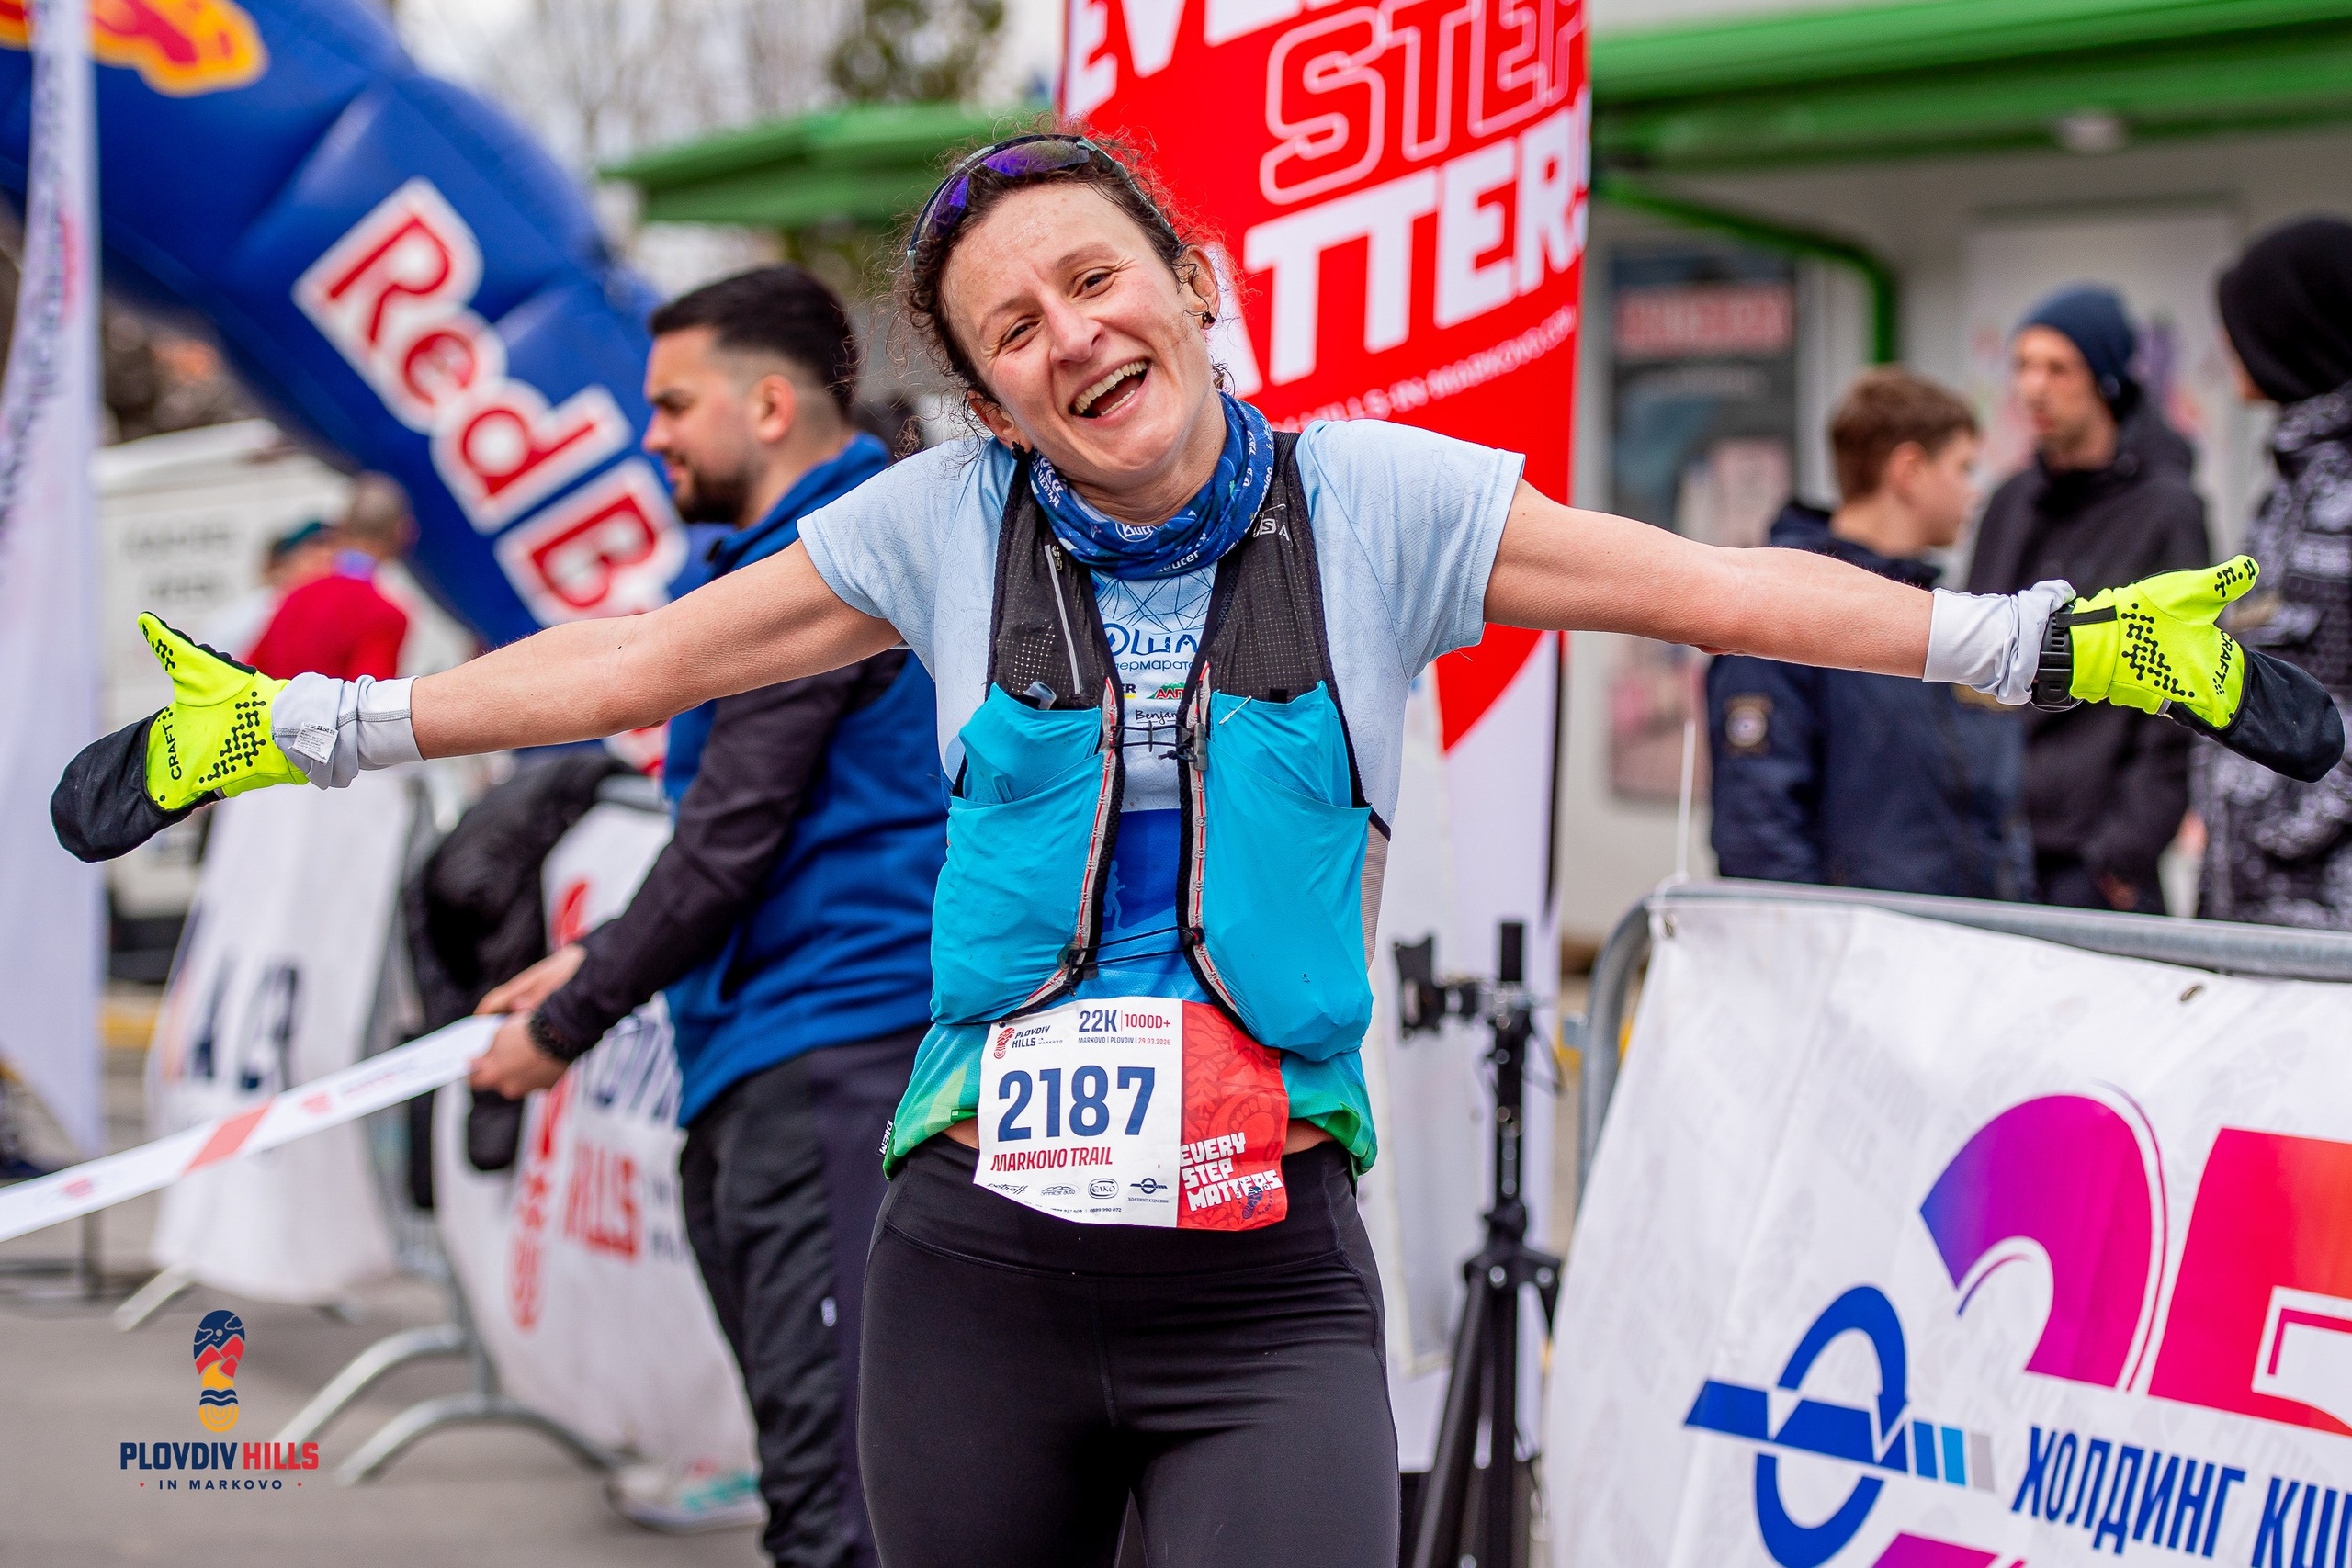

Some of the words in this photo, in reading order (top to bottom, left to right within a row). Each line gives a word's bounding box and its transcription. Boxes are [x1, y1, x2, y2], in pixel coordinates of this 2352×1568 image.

[303, 188, 621, 520] Red
[2216, 630, 2234, 685] CRAFT
[162, 723, 182, 781] CRAFT
[1015, 1025, 1051, 1039] PLOVDIV
[1079, 1010, 1117, 1032] 22K
[1125, 1013, 1171, 1029] 1000D+
[1012, 1037, 1036, 1049] HILLS
[1078, 1036, 1106, 1044] MARKOVO
[1110, 1036, 1135, 1044] PLOVDIV
[997, 1065, 1156, 1143] 2187
[879, 1119, 894, 1156] DIEM
[1180, 1132, 1246, 1168] EVERY
[990, 1149, 1067, 1172] MARKOVO
[1070, 1146, 1113, 1167] TRAIL
[1181, 1158, 1234, 1190] STEP
[1186, 1169, 1283, 1212] MATTERS
[2011, 1426, 2247, 1556] ХОЛДИНГ
